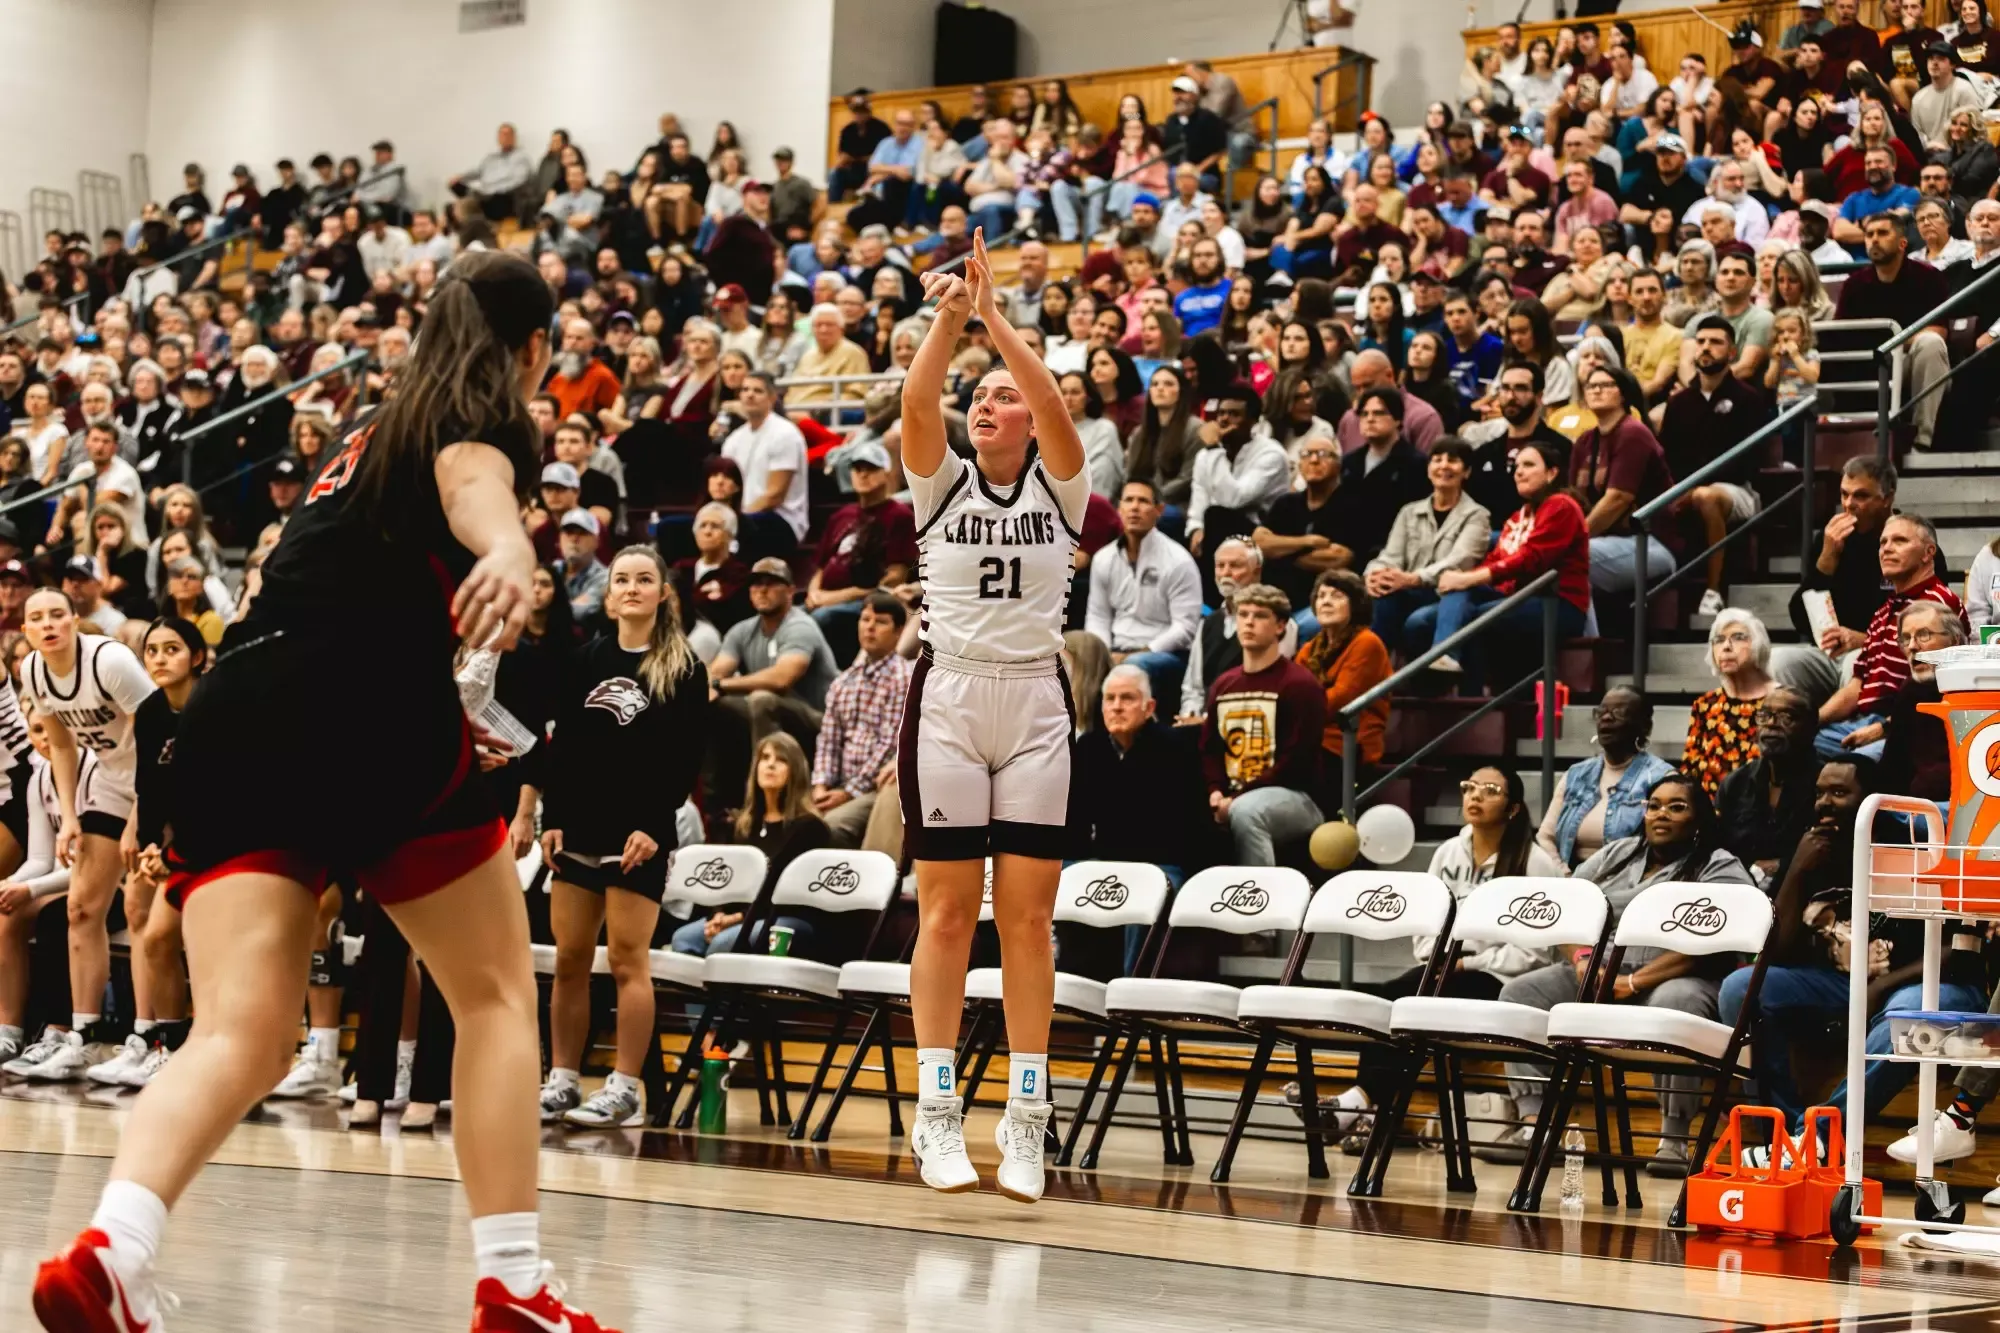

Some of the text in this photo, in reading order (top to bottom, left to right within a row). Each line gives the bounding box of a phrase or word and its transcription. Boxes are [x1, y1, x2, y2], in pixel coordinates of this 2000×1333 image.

[944, 512, 1054, 545] LADY LIONS
[979, 556, 1022, 599] 21
[684, 857, 733, 889] Lions
[808, 862, 860, 895] Lions
[1075, 874, 1129, 910] Lions
[1210, 880, 1270, 916] Lions
[1345, 884, 1407, 922] Lions
[1497, 891, 1562, 929] Lions
[1660, 897, 1727, 937] Lions
[1719, 1190, 1744, 1222] G
